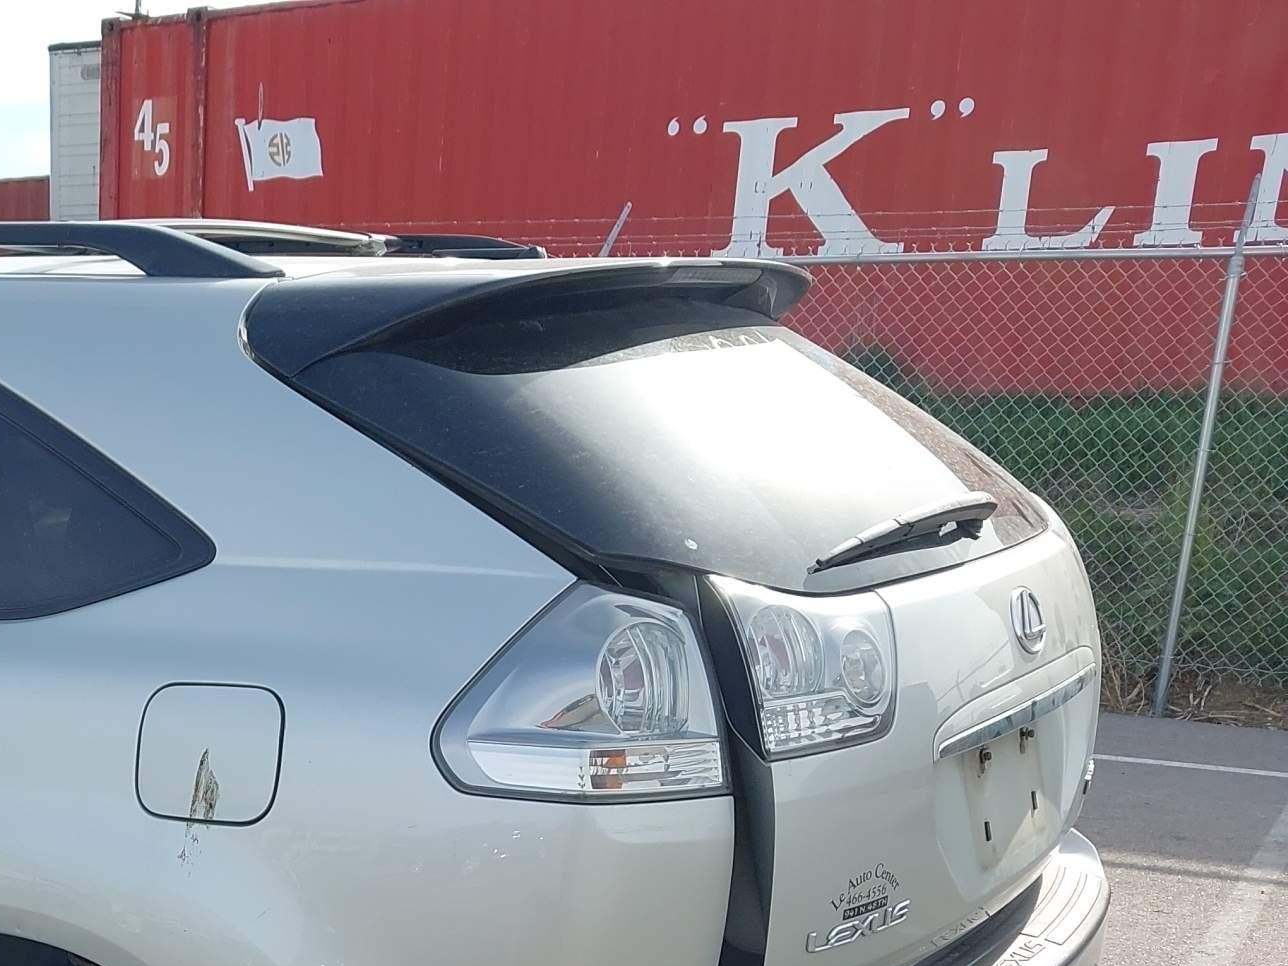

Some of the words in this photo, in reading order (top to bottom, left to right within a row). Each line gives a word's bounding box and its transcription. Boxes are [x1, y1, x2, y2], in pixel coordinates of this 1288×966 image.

[134, 99, 170, 177] 45
[848, 870, 872, 894] Auto
[874, 862, 900, 891] Center
[805, 899, 911, 953] LEXUS
